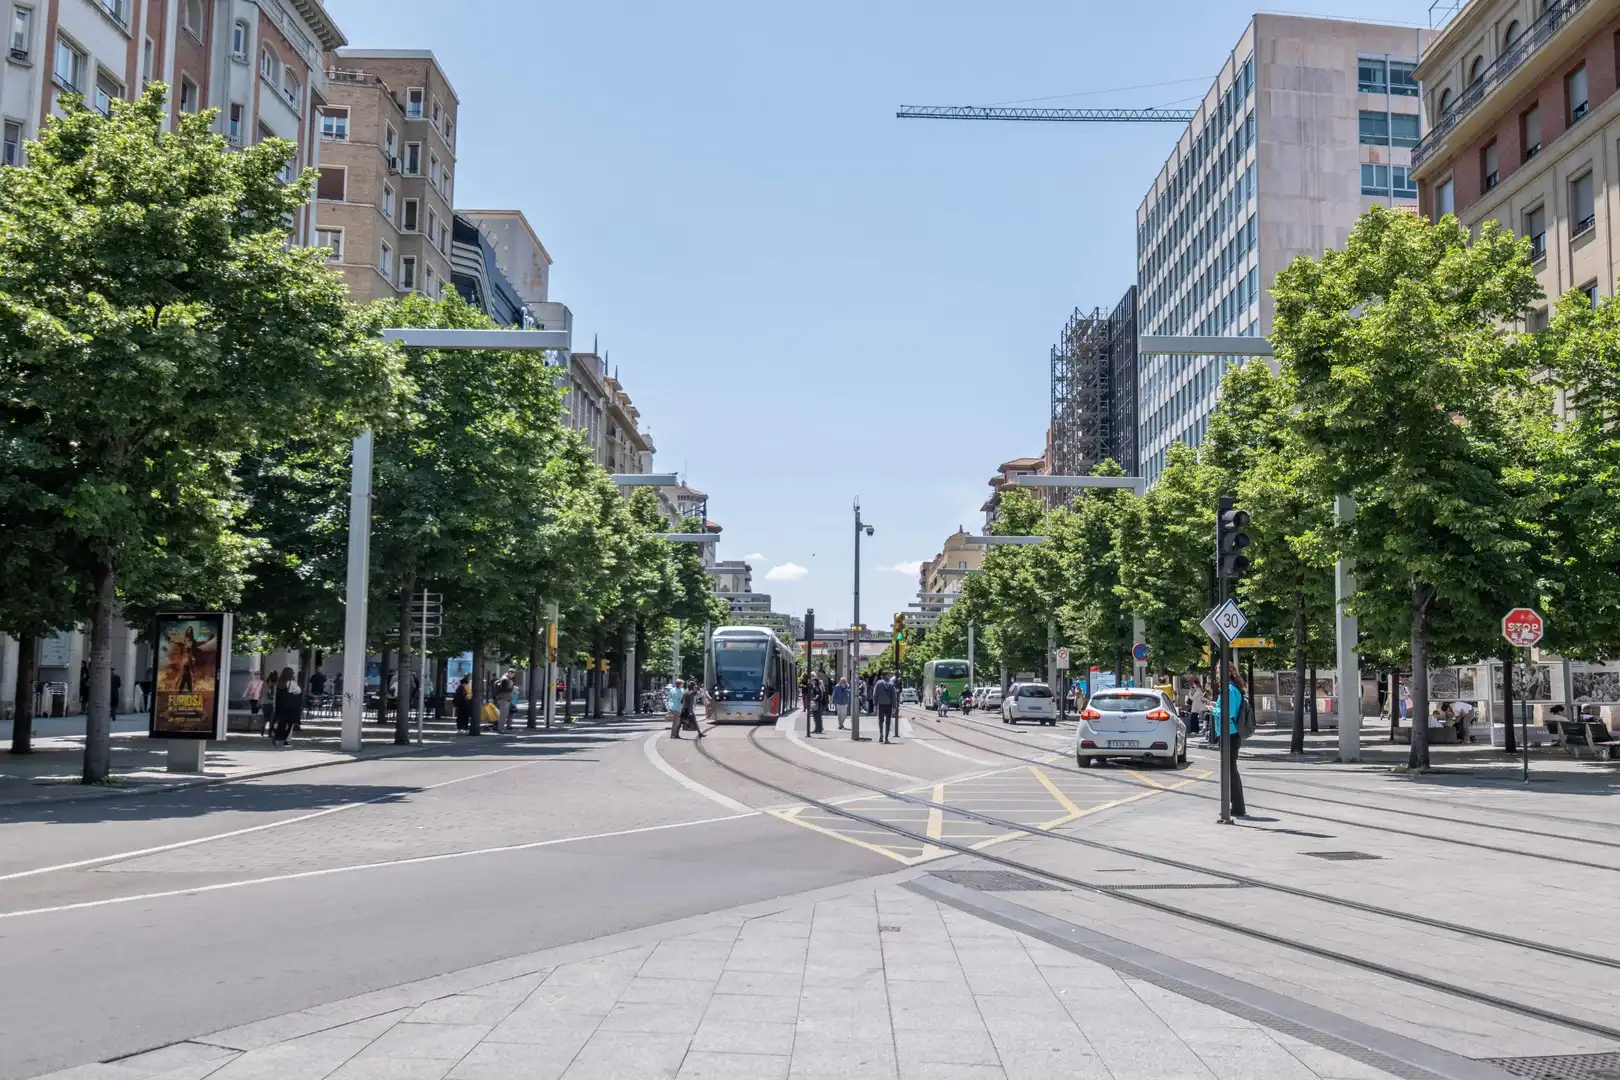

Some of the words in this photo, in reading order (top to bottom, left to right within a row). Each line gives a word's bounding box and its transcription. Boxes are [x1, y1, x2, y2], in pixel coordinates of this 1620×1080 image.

[1223, 613, 1239, 629] 30
[1507, 622, 1539, 632] STOP
[168, 694, 203, 707] FURIOSA
